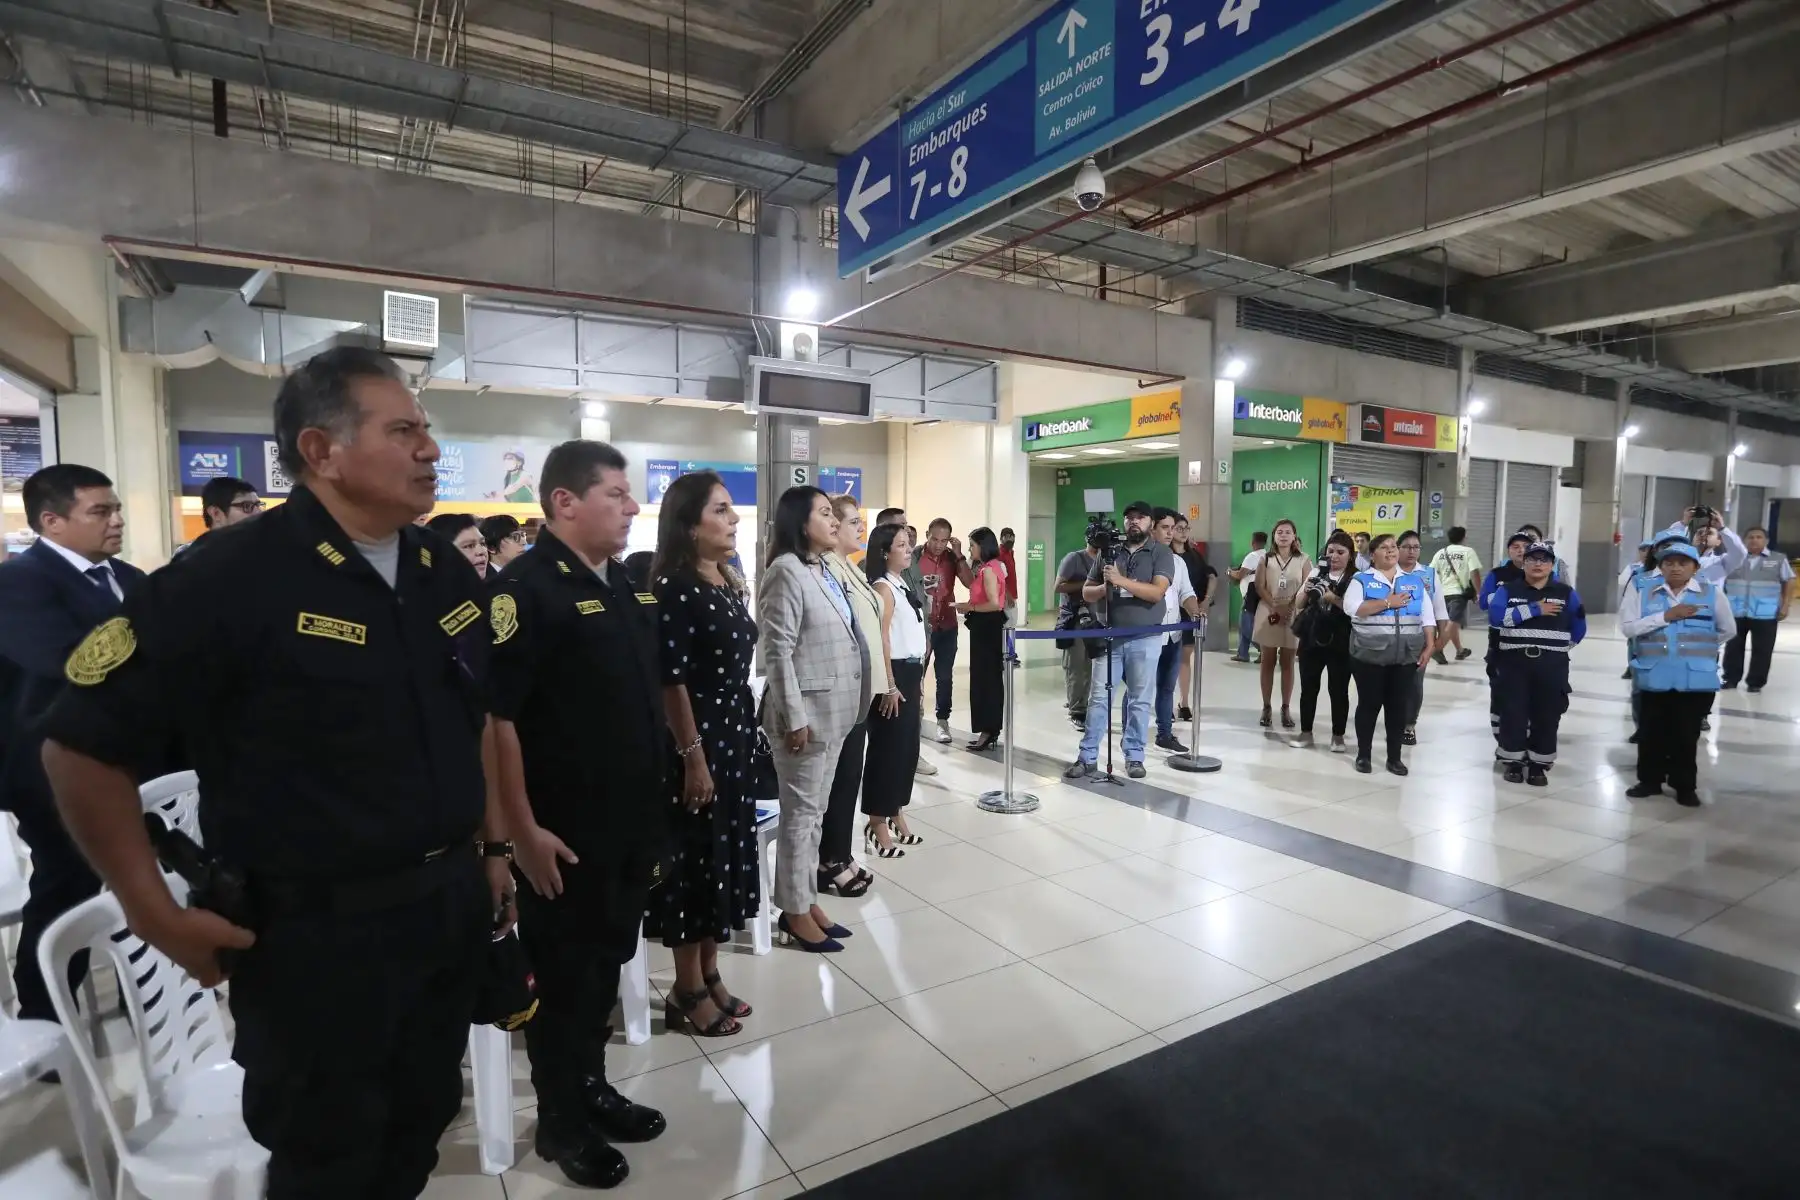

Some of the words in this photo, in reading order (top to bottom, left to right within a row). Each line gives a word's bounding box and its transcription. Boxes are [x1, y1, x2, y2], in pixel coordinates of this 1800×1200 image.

[1038, 66, 1073, 97] SALIDA
[1075, 42, 1112, 75] NORTE
[1043, 93, 1073, 116] Centro
[1074, 75, 1104, 98] Cívico
[908, 111, 935, 139] Hacia
[936, 99, 946, 120] el
[947, 90, 967, 113] Sur
[1048, 126, 1063, 140] Av.
[1064, 105, 1097, 131] Bolivia
[908, 102, 988, 168] Embarques
[1137, 411, 1173, 427] globalnet
[1248, 402, 1303, 424] Interbank
[1039, 416, 1090, 437] Interbank
[1307, 417, 1336, 430] globalnet
[189, 453, 228, 468] ATU
[649, 463, 677, 471] Embarque
[1220, 462, 1227, 474] S
[659, 474, 671, 494] 8
[794, 468, 806, 484] S
[844, 480, 855, 496] 7
[1255, 478, 1309, 493] Interbank
[1432, 510, 1440, 520] S
[313, 619, 353, 633] MORALES
